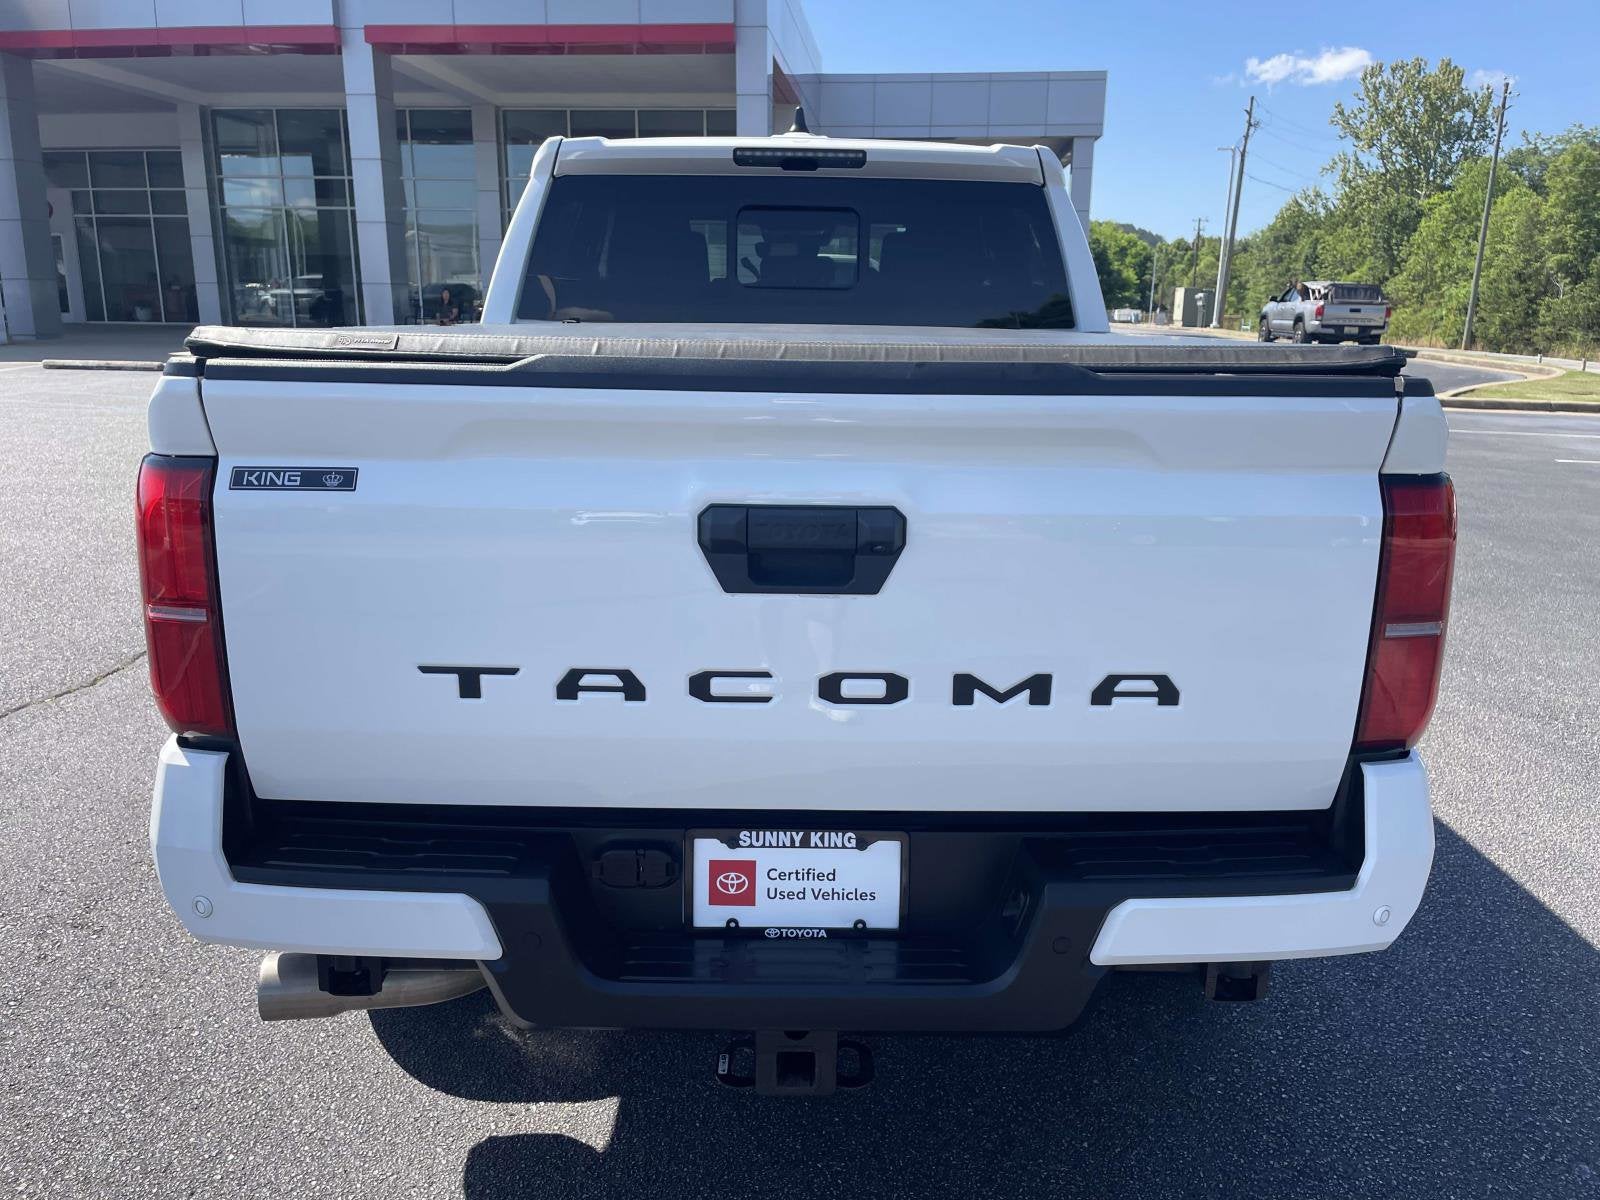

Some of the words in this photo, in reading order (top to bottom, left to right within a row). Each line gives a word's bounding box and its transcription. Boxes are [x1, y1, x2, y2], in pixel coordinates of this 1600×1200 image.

[242, 471, 301, 486] KING
[417, 665, 1181, 706] TACOMA
[739, 831, 804, 847] SUNNY
[810, 832, 856, 848] KING
[766, 868, 836, 882] Certified
[766, 887, 806, 900] Used
[811, 888, 876, 901] Vehicles
[780, 929, 827, 938] TOYOTA
